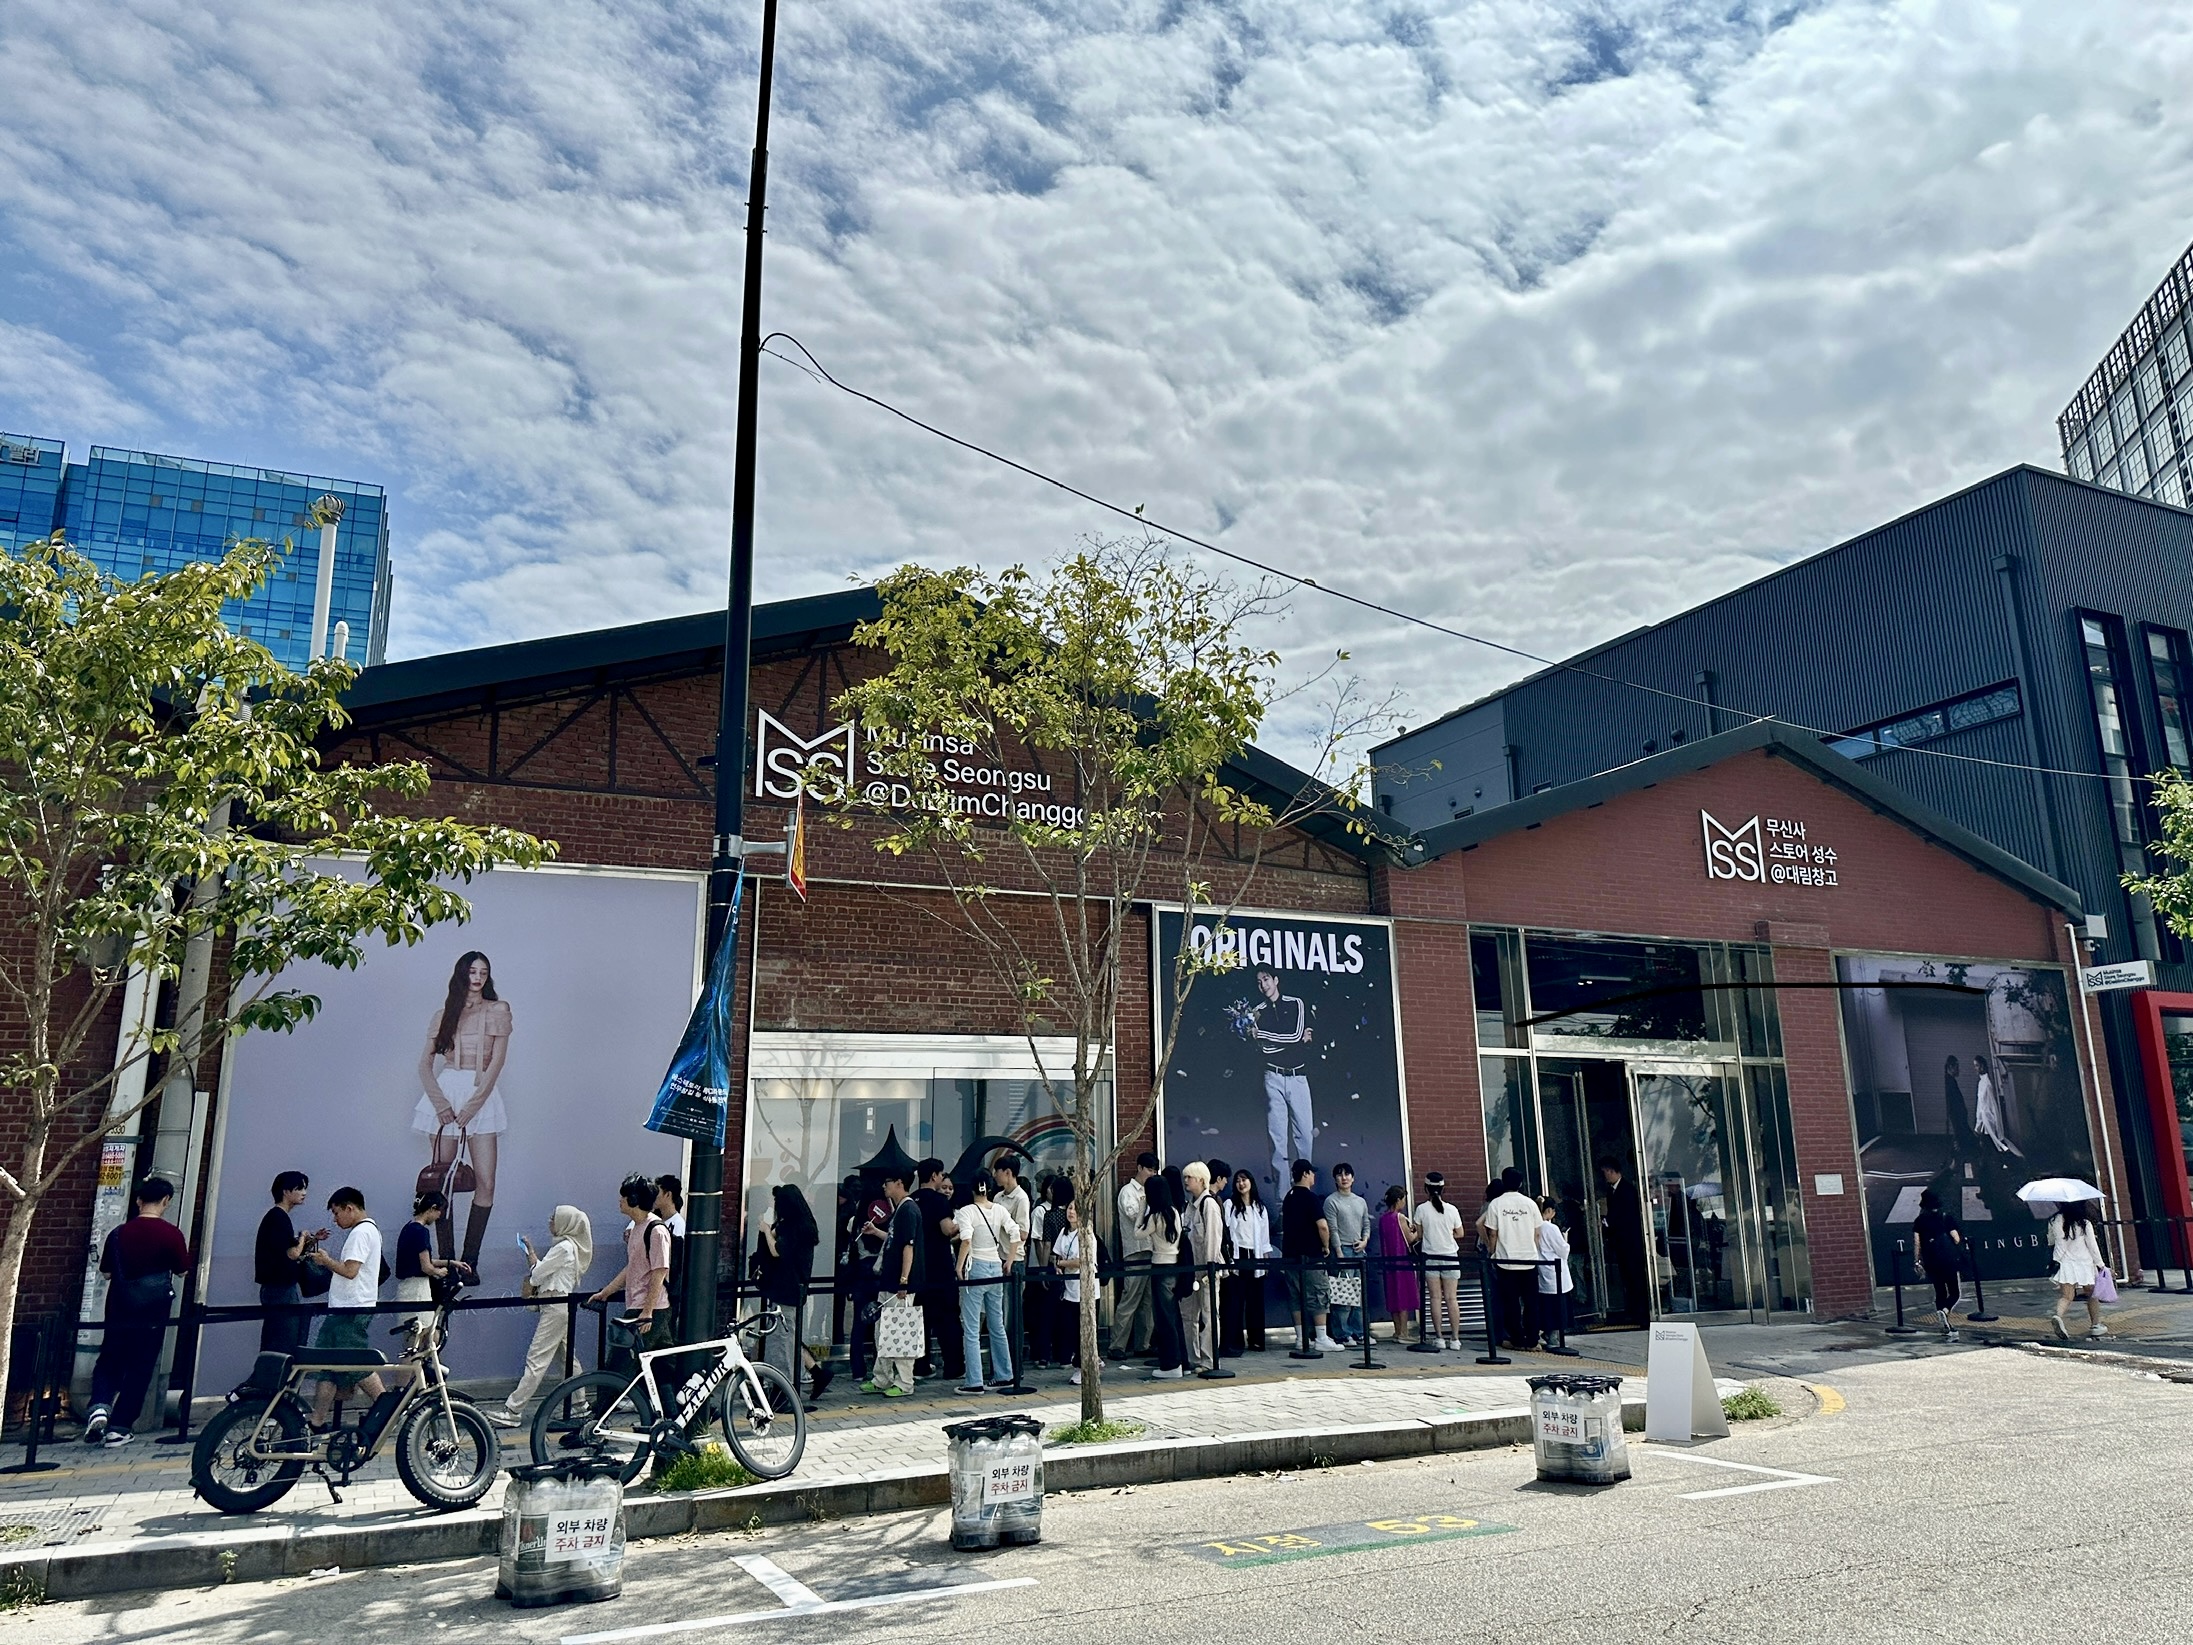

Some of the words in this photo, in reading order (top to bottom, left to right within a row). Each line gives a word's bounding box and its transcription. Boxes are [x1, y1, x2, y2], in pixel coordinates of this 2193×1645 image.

[943, 758, 1052, 794] Seongsu
[1766, 818, 1806, 840] 무신사
[1769, 842, 1809, 862] 스토어
[1812, 845, 1838, 866] 성수
[1770, 863, 1838, 887] @대림창고
[1190, 924, 1364, 974] ORIGINALS
[682, 1361, 728, 1422] FACTOR
[1542, 1410, 1559, 1421] 외부
[1561, 1413, 1578, 1424] 차량
[1543, 1423, 1560, 1435] 주차
[1562, 1426, 1578, 1437] 금지
[992, 1468, 1010, 1480] 외부
[1012, 1465, 1030, 1477] 차량
[991, 1483, 1009, 1495] 주차
[1011, 1480, 1028, 1491] 금지
[556, 1519, 580, 1535] 외부
[584, 1518, 608, 1532] 차량
[1365, 1514, 1480, 1534] 53
[555, 1536, 579, 1551] 주차
[583, 1534, 605, 1548] 금지
